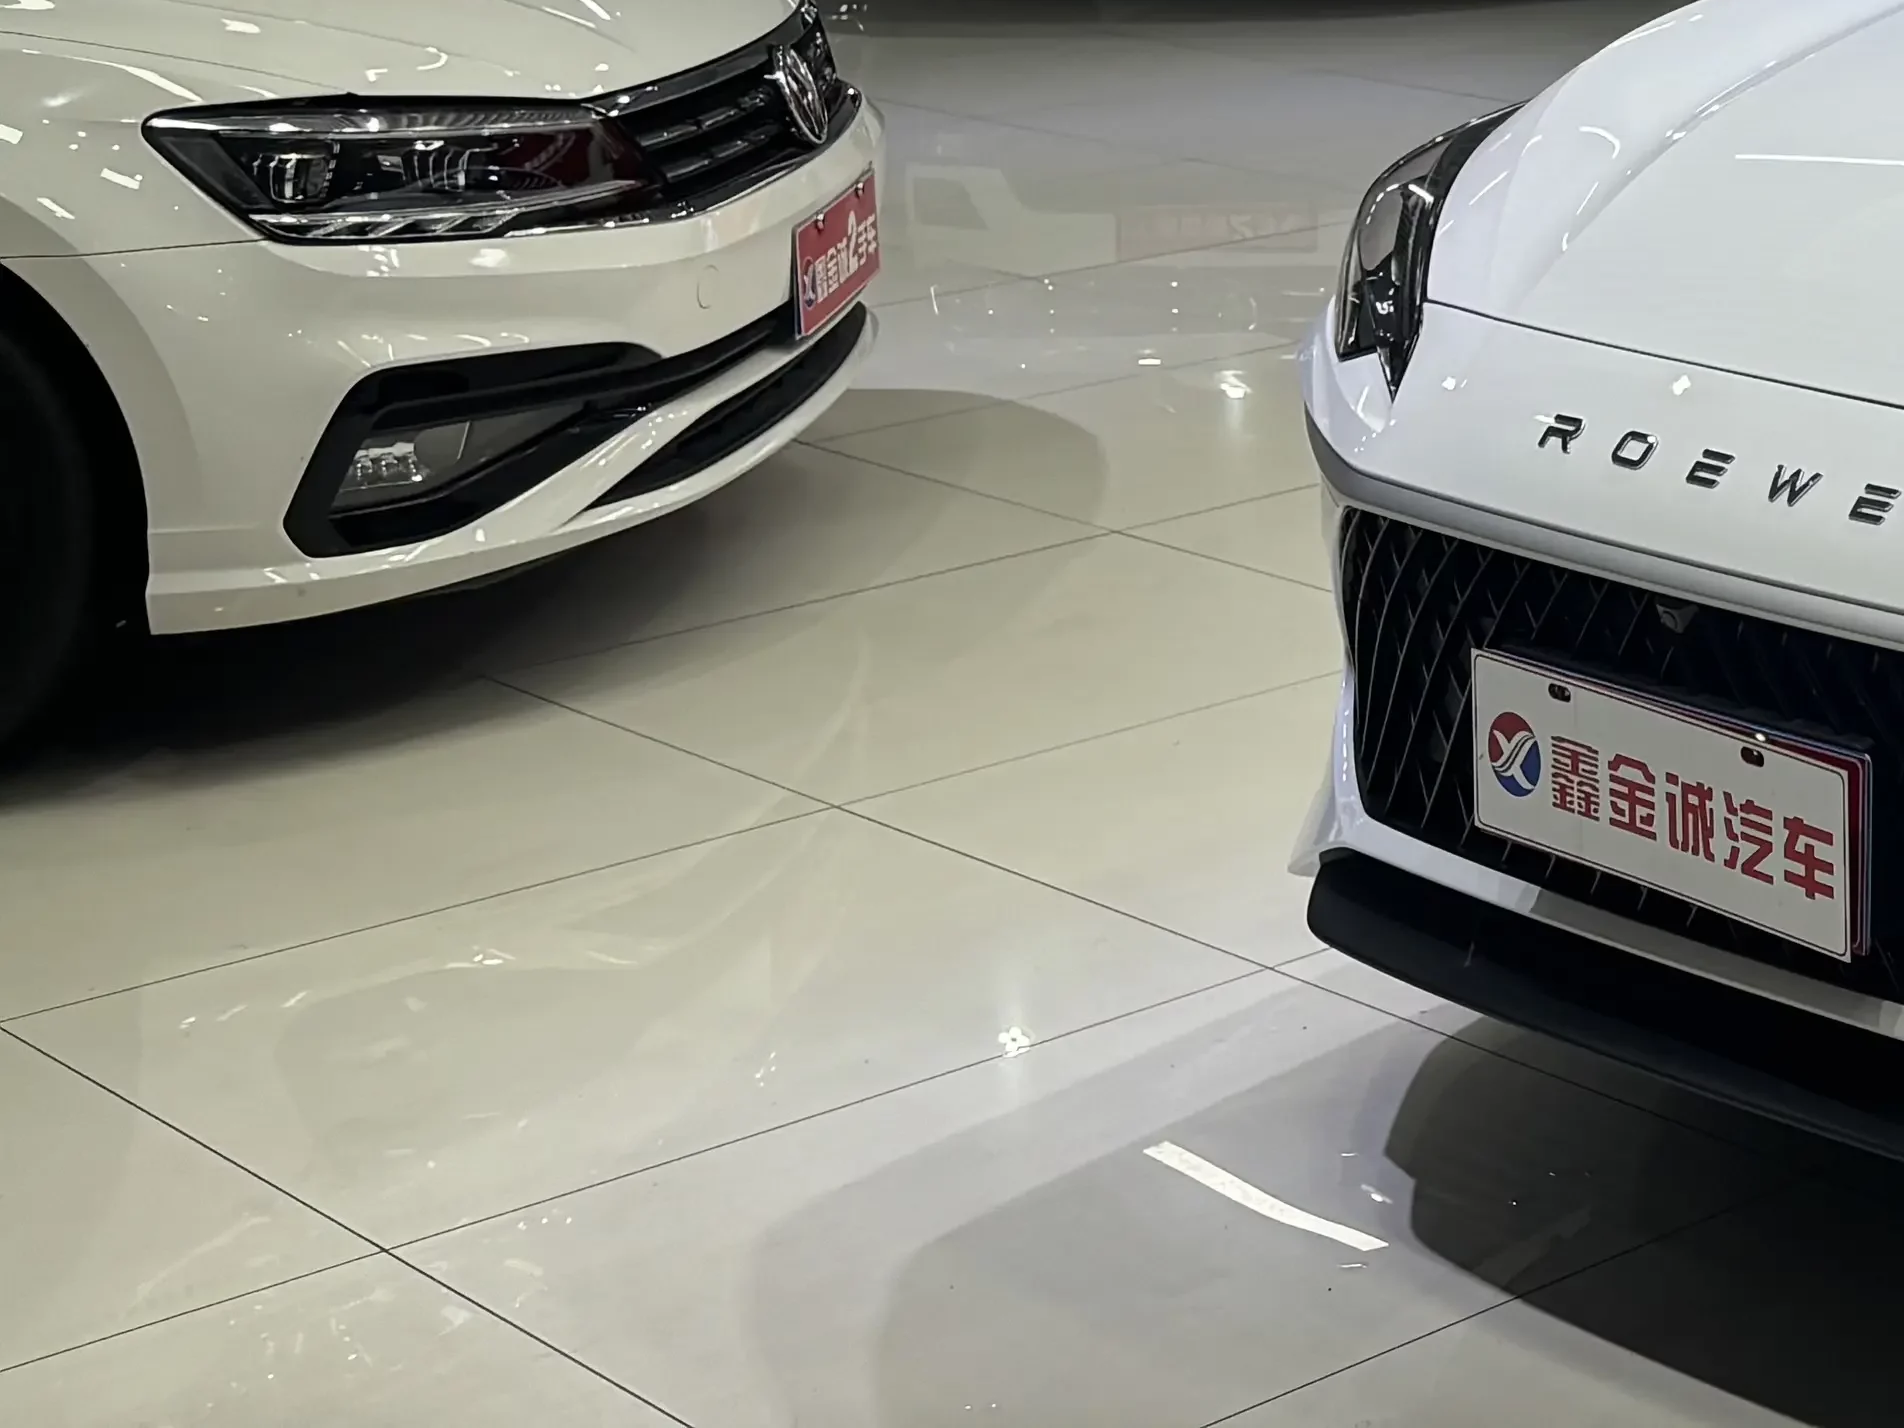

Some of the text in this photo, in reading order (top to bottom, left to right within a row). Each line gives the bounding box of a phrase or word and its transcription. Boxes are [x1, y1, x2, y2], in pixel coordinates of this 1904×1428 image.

[1537, 412, 1902, 526] ROEWE
[1549, 734, 1837, 901] 鑫金诚汽车
